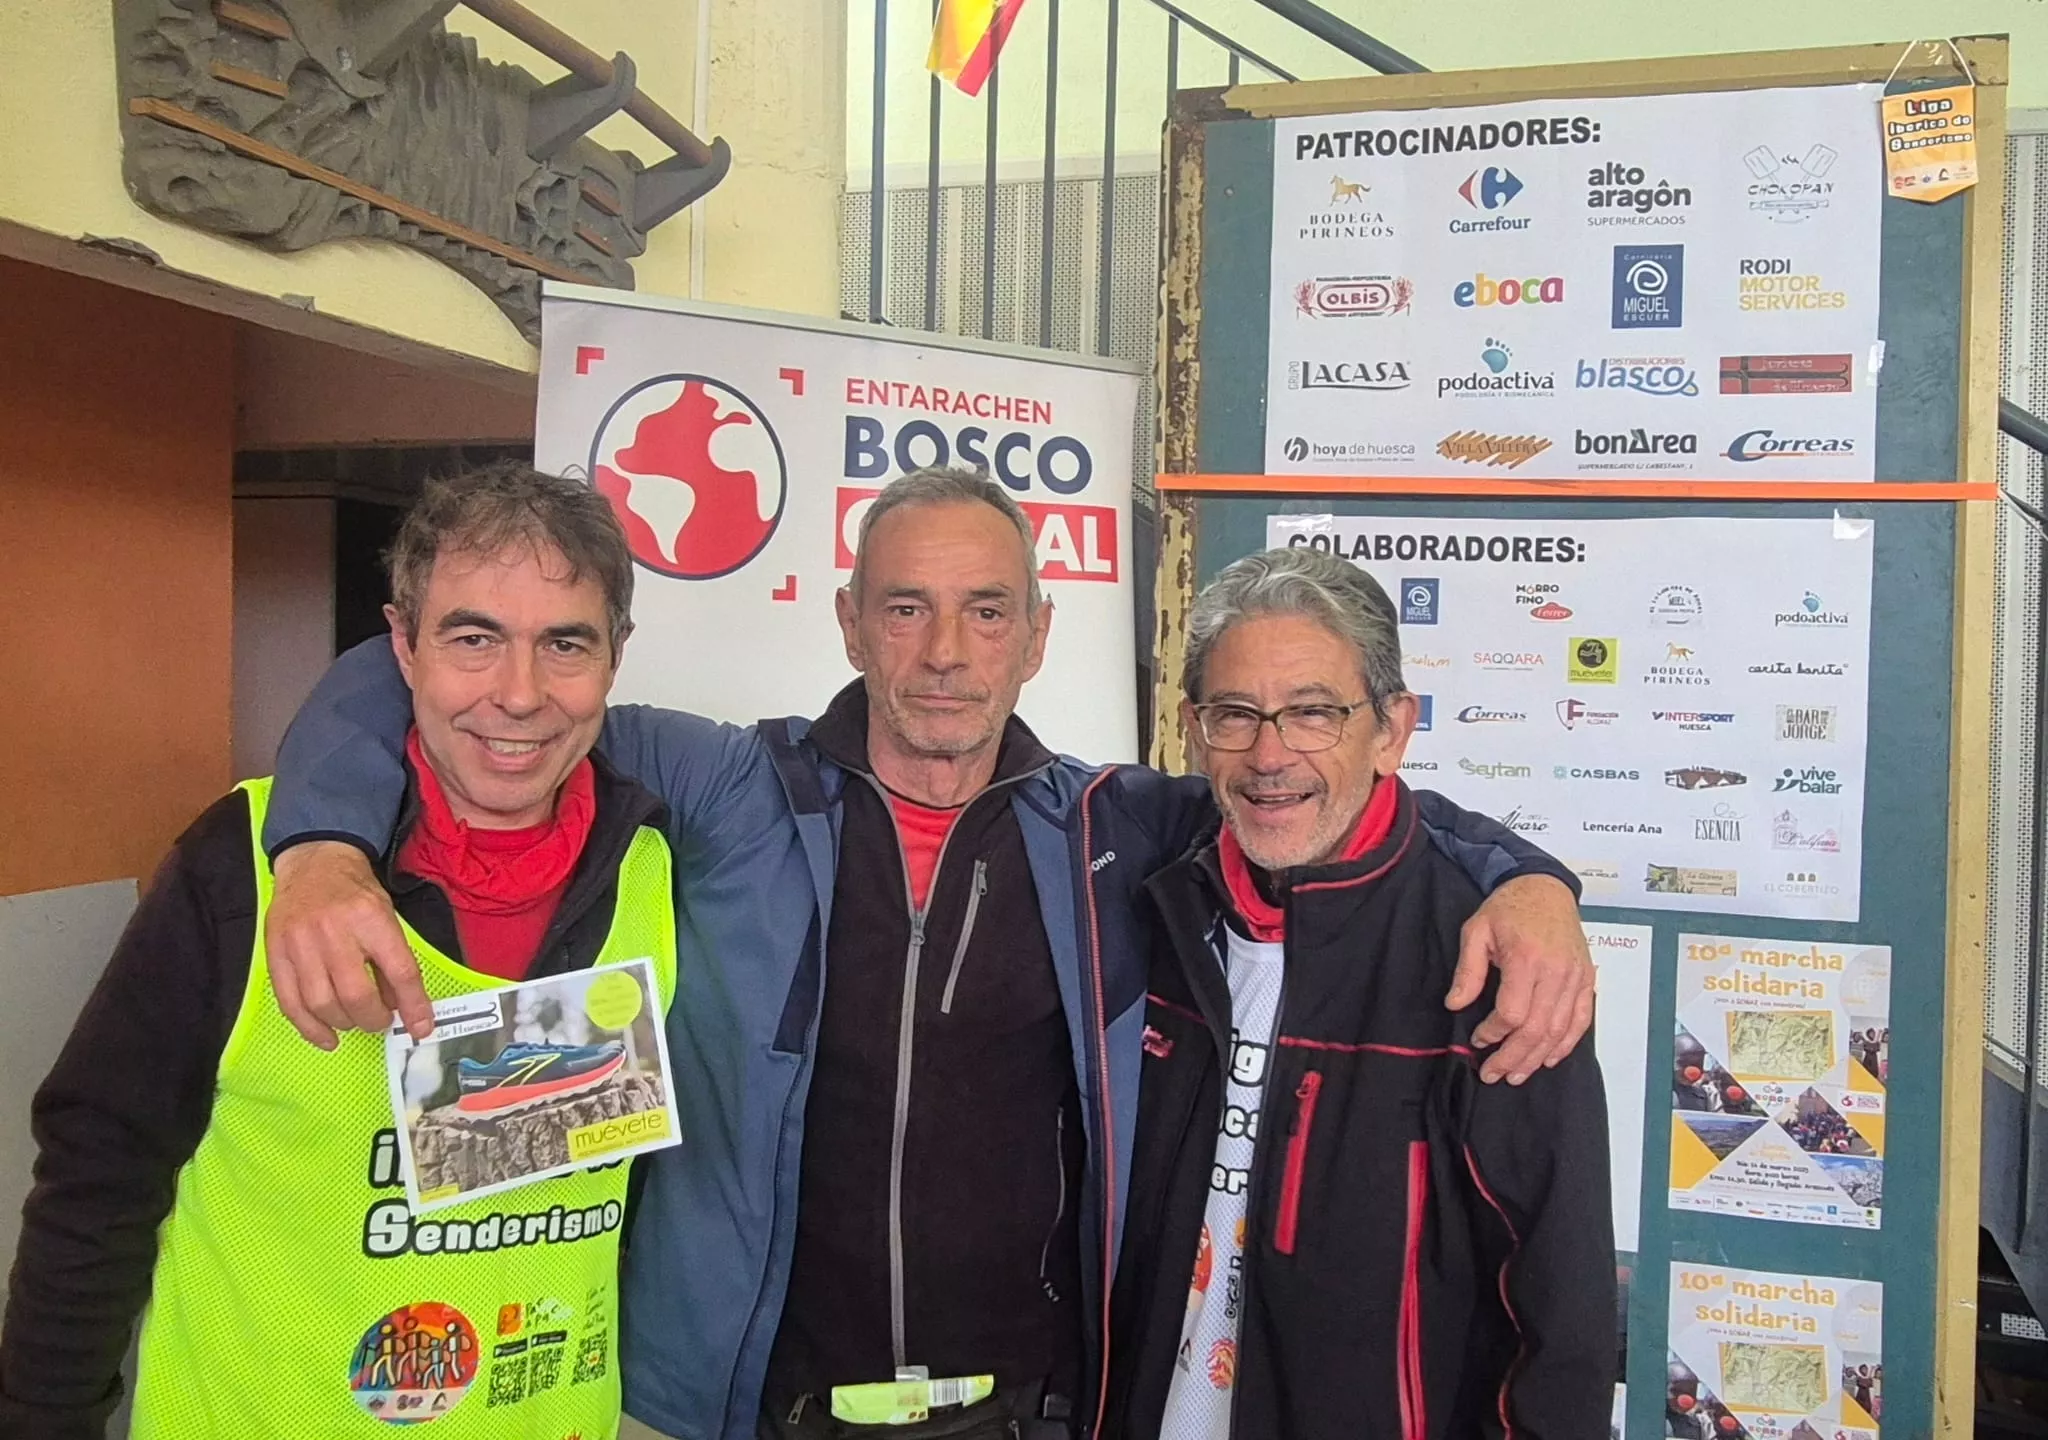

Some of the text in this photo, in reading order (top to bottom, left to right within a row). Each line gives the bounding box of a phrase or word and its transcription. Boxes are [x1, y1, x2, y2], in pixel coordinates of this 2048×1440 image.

[1906, 98, 1952, 116] Liga
[1952, 115, 1972, 127] de
[1296, 117, 1600, 160] PATROCINADORES:
[1890, 133, 1972, 152] Senderismo
[1588, 162, 1645, 186] alto
[1748, 183, 1834, 195] CHOKOPAN
[1310, 213, 1384, 226] BODEGA
[1449, 216, 1532, 234] Carrefour
[1587, 215, 1686, 227] SUPERMERCADOS
[1300, 226, 1394, 240] PIRINEOS
[1740, 259, 1790, 275] RODI
[1454, 273, 1563, 308] eboca
[1740, 276, 1820, 293] MOTOR
[1624, 297, 1669, 313] MIGUEL
[1739, 292, 1845, 312] SERVICES
[1623, 313, 1669, 321] ESCUER
[1288, 361, 1299, 389] GRUPO
[1302, 361, 1410, 389] LACASA
[1576, 358, 1685, 388] blasco
[1438, 371, 1554, 398] podoactiva
[846, 378, 1051, 424] ENTARACHEN
[1313, 443, 1415, 457] hoya de huesca
[1575, 428, 1697, 455] bonArea
[1727, 430, 1854, 462] Correas
[845, 415, 1093, 495] BOSCO
[1289, 533, 1585, 563] COLABORADORES:
[1516, 596, 1544, 605] FINO
[1775, 611, 1848, 626] podoactiva
[1473, 652, 1544, 665] SAQQARA
[1651, 667, 1703, 676] BODEGA
[1748, 662, 1843, 676] carita bonita
[1644, 677, 1711, 686] PIRINEOS
[1458, 706, 1527, 723] Correas
[1666, 711, 1735, 723] INTERSPORT
[1795, 708, 1819, 725] BAR
[1679, 723, 1712, 732] HUESCA
[1783, 724, 1827, 740] JORGE
[1402, 760, 1438, 770] uesca
[1800, 766, 1836, 781] vive
[1571, 768, 1640, 780] CASBAS
[1800, 782, 1843, 795] balar
[1583, 821, 1663, 835] Lencería Ana
[1695, 819, 1741, 841] ESENCIA
[1739, 945, 1844, 972] marcha
[1702, 969, 1826, 1000] solidaria
[576, 1112, 662, 1148] muévete
[365, 1201, 621, 1257] Senderismo
[1731, 1279, 1836, 1306] marcha
[1695, 1300, 1817, 1333] solidaria
